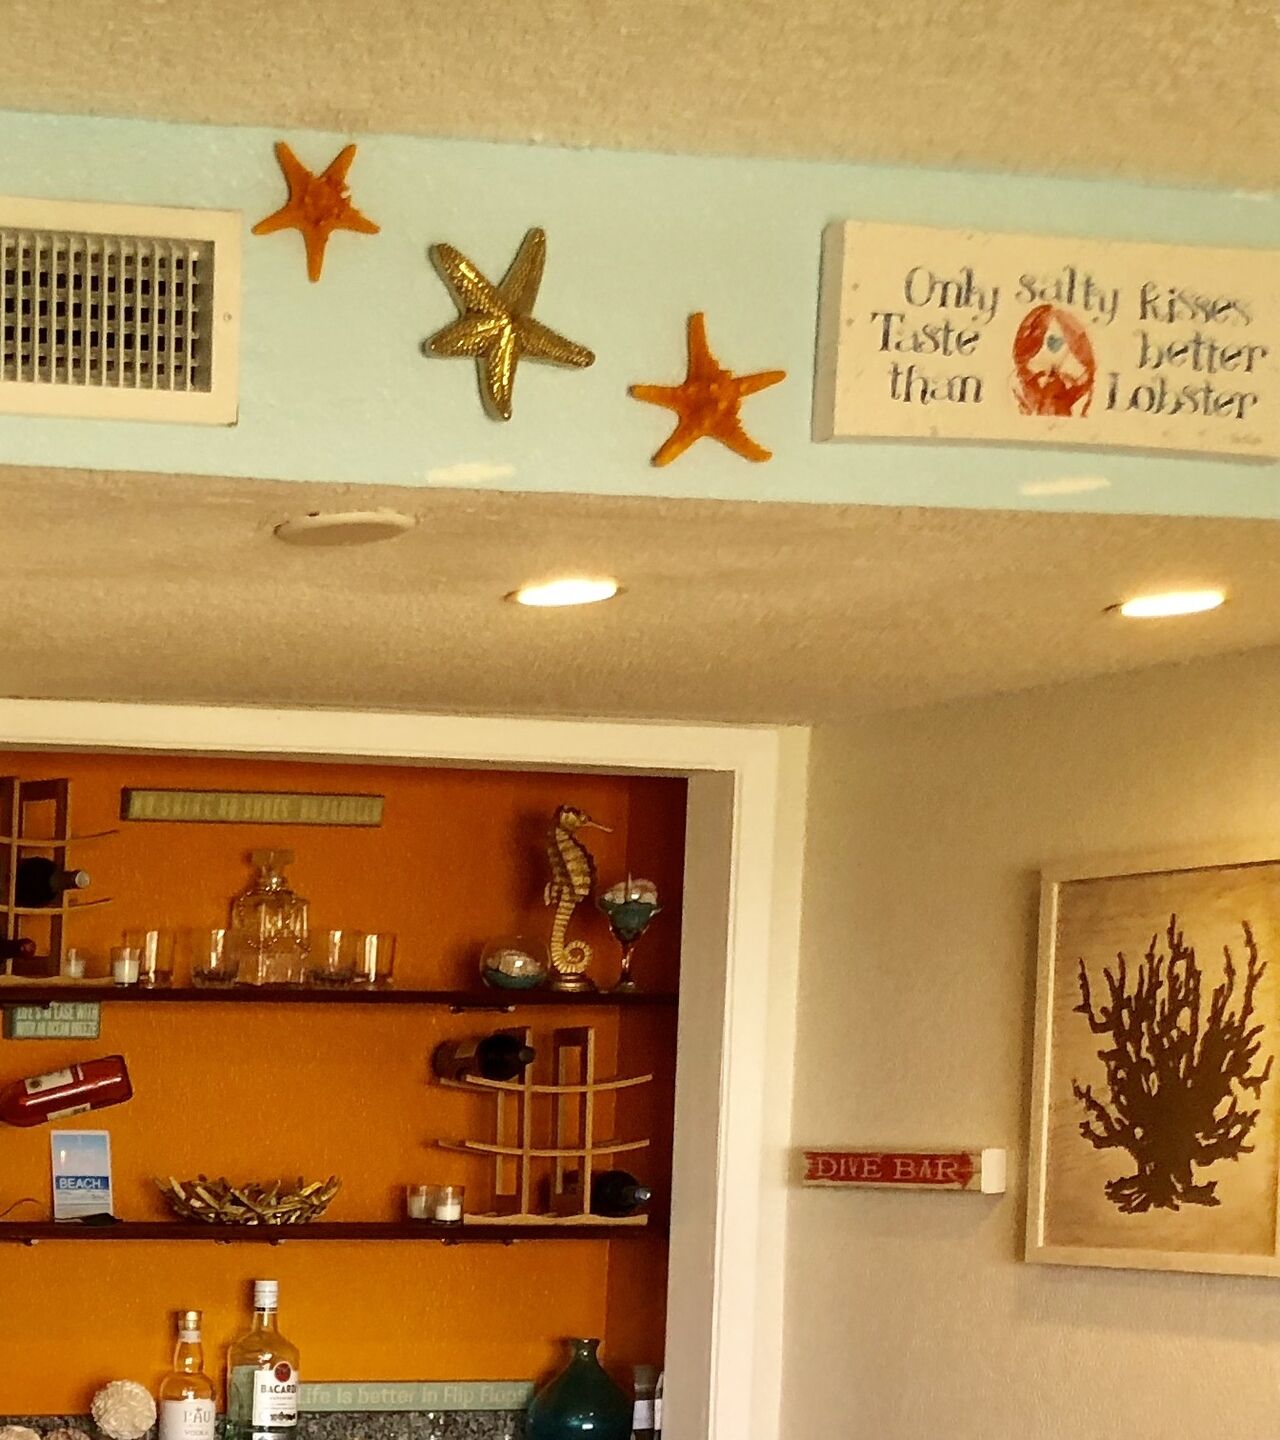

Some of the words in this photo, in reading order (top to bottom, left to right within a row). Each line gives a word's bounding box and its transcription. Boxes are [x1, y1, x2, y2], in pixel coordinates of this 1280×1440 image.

[904, 265, 1000, 325] Only
[870, 311, 981, 356] Taste
[1136, 328, 1269, 374] better
[889, 361, 983, 405] than
[1105, 372, 1259, 420] Lobster
[59, 1177, 102, 1190] BEACH
[815, 1156, 882, 1179] DIVE
[892, 1157, 961, 1181] BAR
[260, 1384, 297, 1394] BACARD
[298, 1385, 330, 1404] Life
[358, 1385, 413, 1404] better
[444, 1386, 474, 1408] Flip
